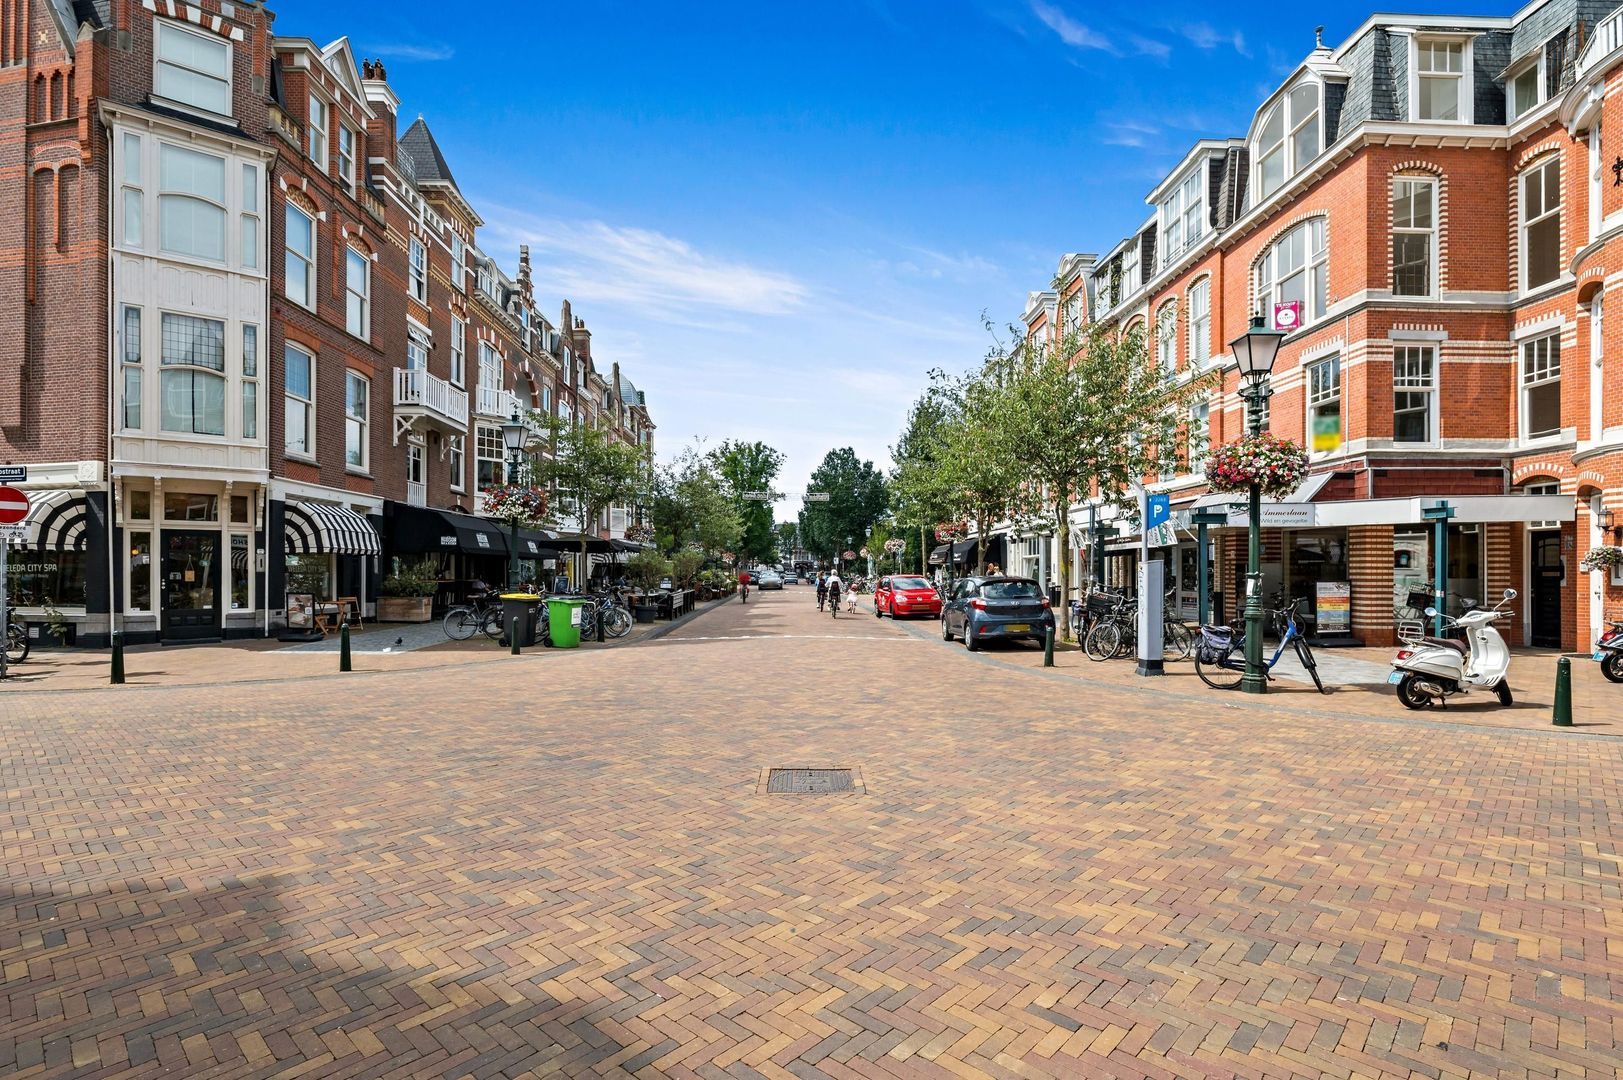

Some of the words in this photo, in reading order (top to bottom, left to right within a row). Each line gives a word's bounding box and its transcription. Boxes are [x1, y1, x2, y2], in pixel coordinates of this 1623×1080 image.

[1153, 504, 1163, 518] P
[5, 563, 26, 572] ELEDA
[27, 563, 43, 572] CITY
[43, 563, 58, 572] SPA
